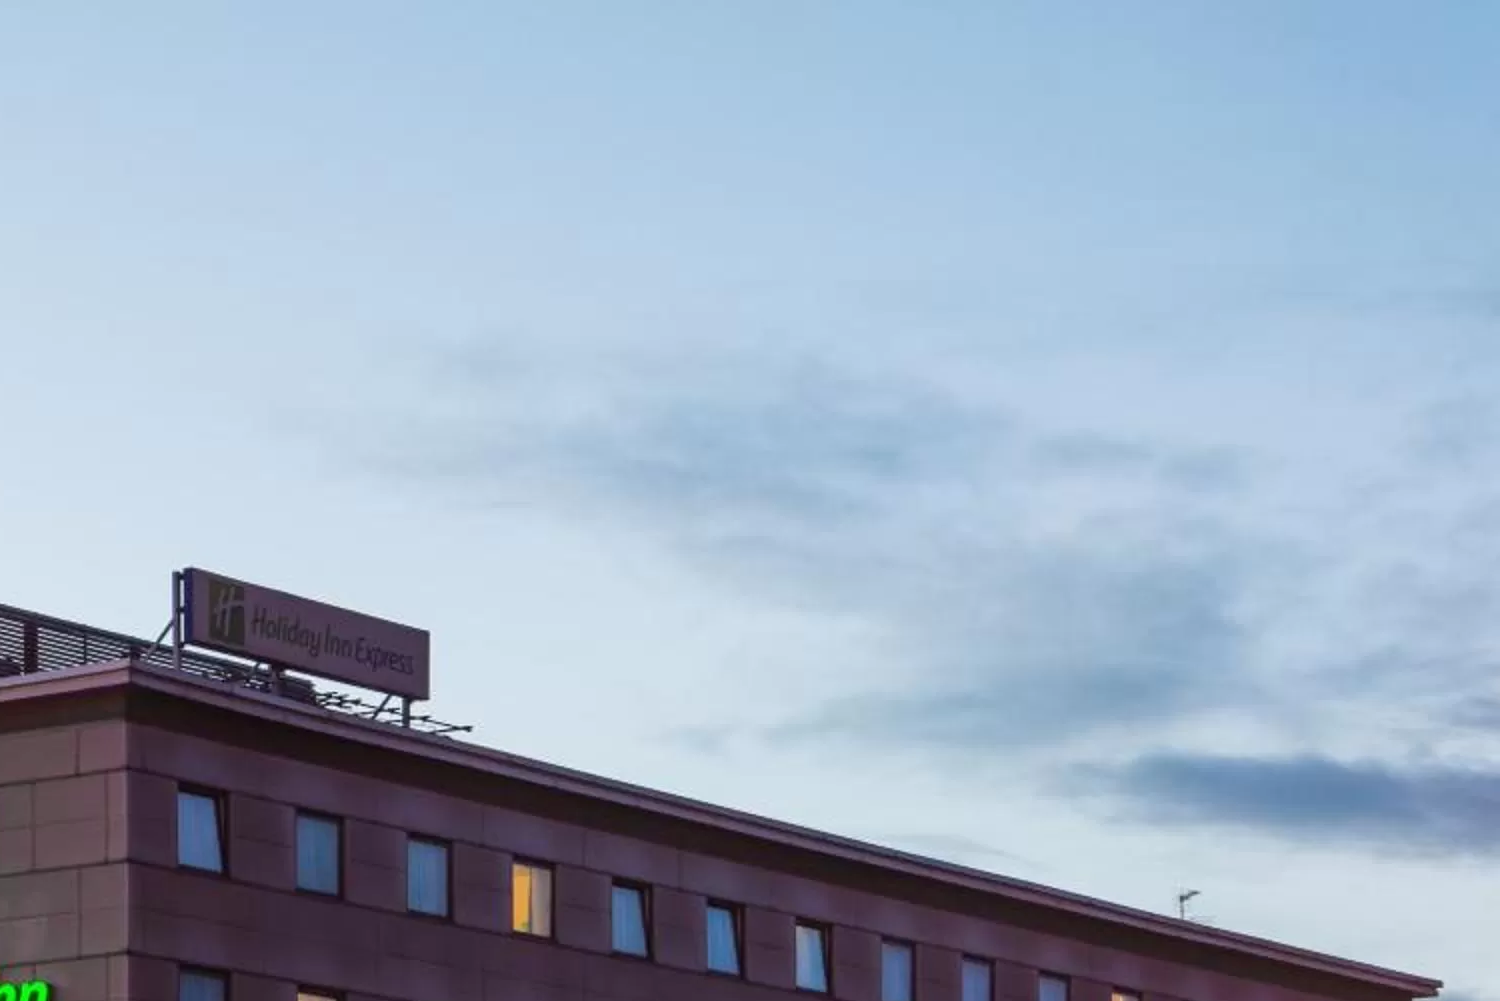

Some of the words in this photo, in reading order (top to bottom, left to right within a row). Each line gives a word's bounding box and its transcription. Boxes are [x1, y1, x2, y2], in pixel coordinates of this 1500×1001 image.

[251, 606, 321, 658] Holiday
[324, 623, 352, 657] Inn
[354, 635, 414, 675] Express
